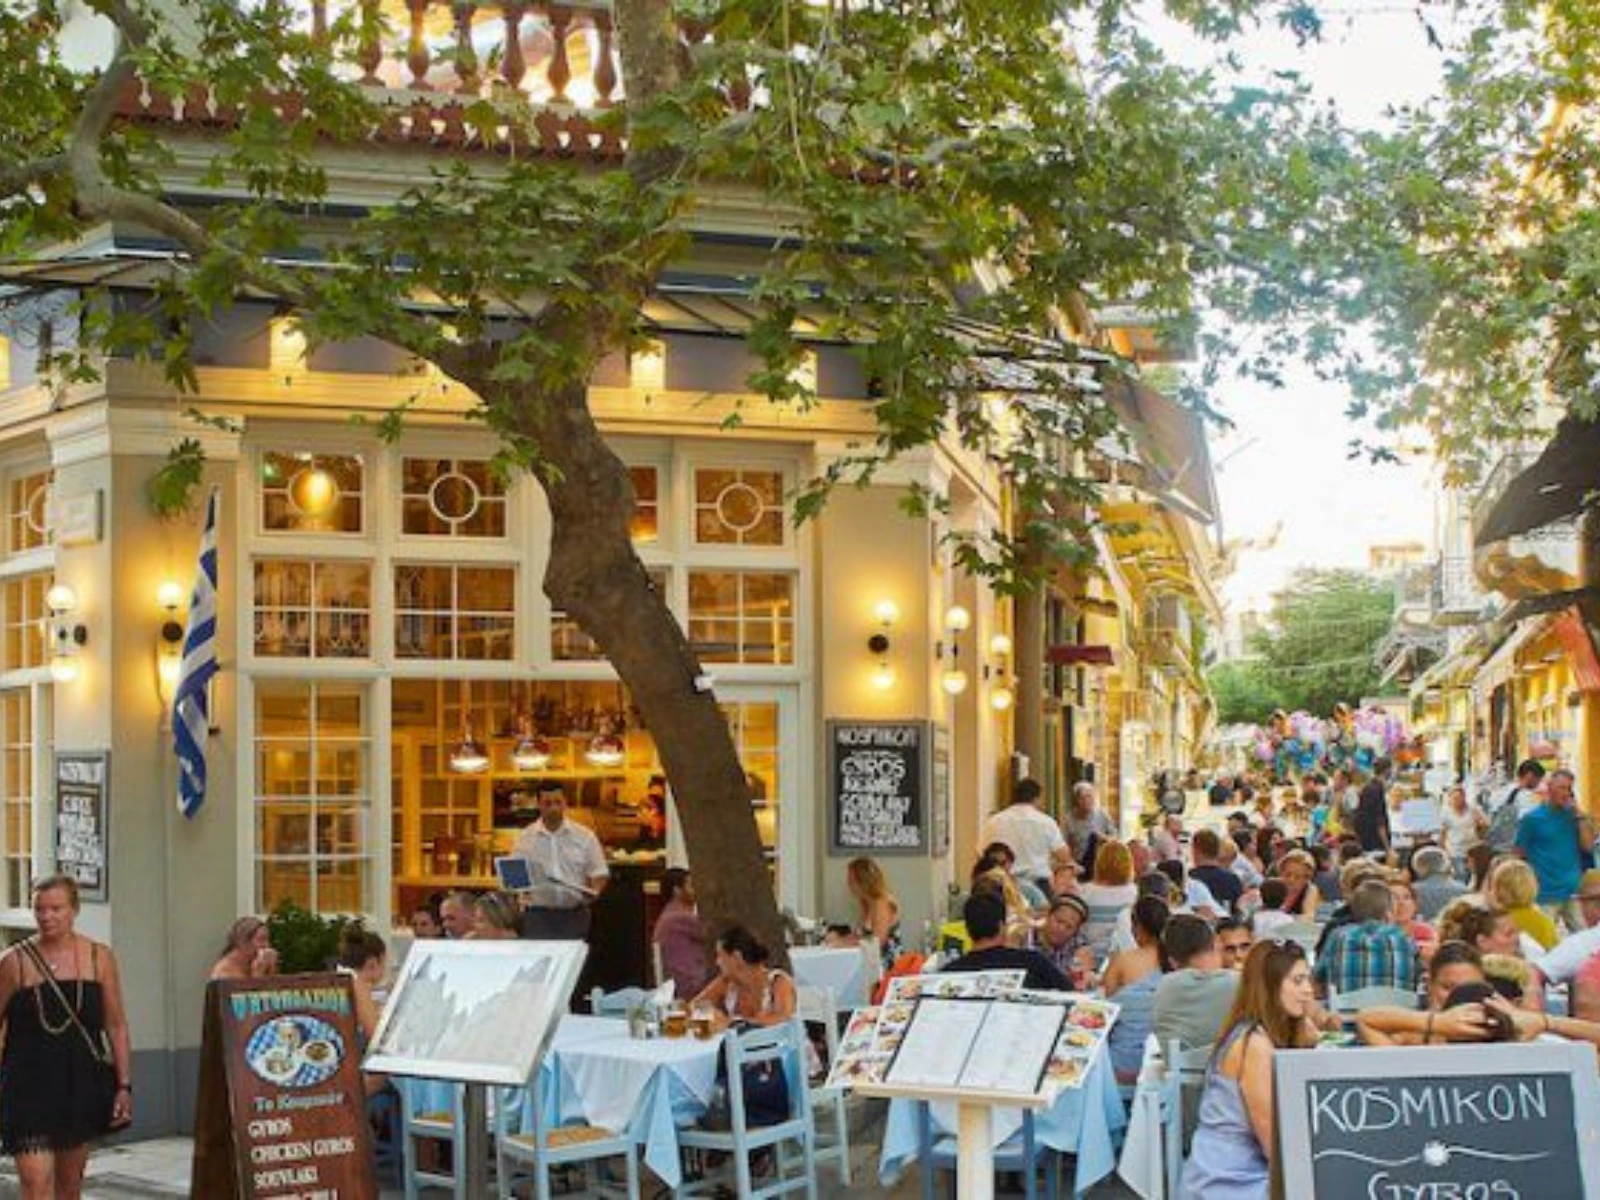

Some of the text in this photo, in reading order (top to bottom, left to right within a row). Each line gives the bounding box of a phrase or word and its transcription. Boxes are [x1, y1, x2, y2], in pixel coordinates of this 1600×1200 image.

[841, 757, 906, 779] GYROS
[1309, 1080, 1546, 1134] KOSMIKON
[248, 1117, 292, 1138] GYROS
[251, 1137, 355, 1163] CHICKEN GYROS
[254, 1166, 318, 1188] SOUVLAKI
